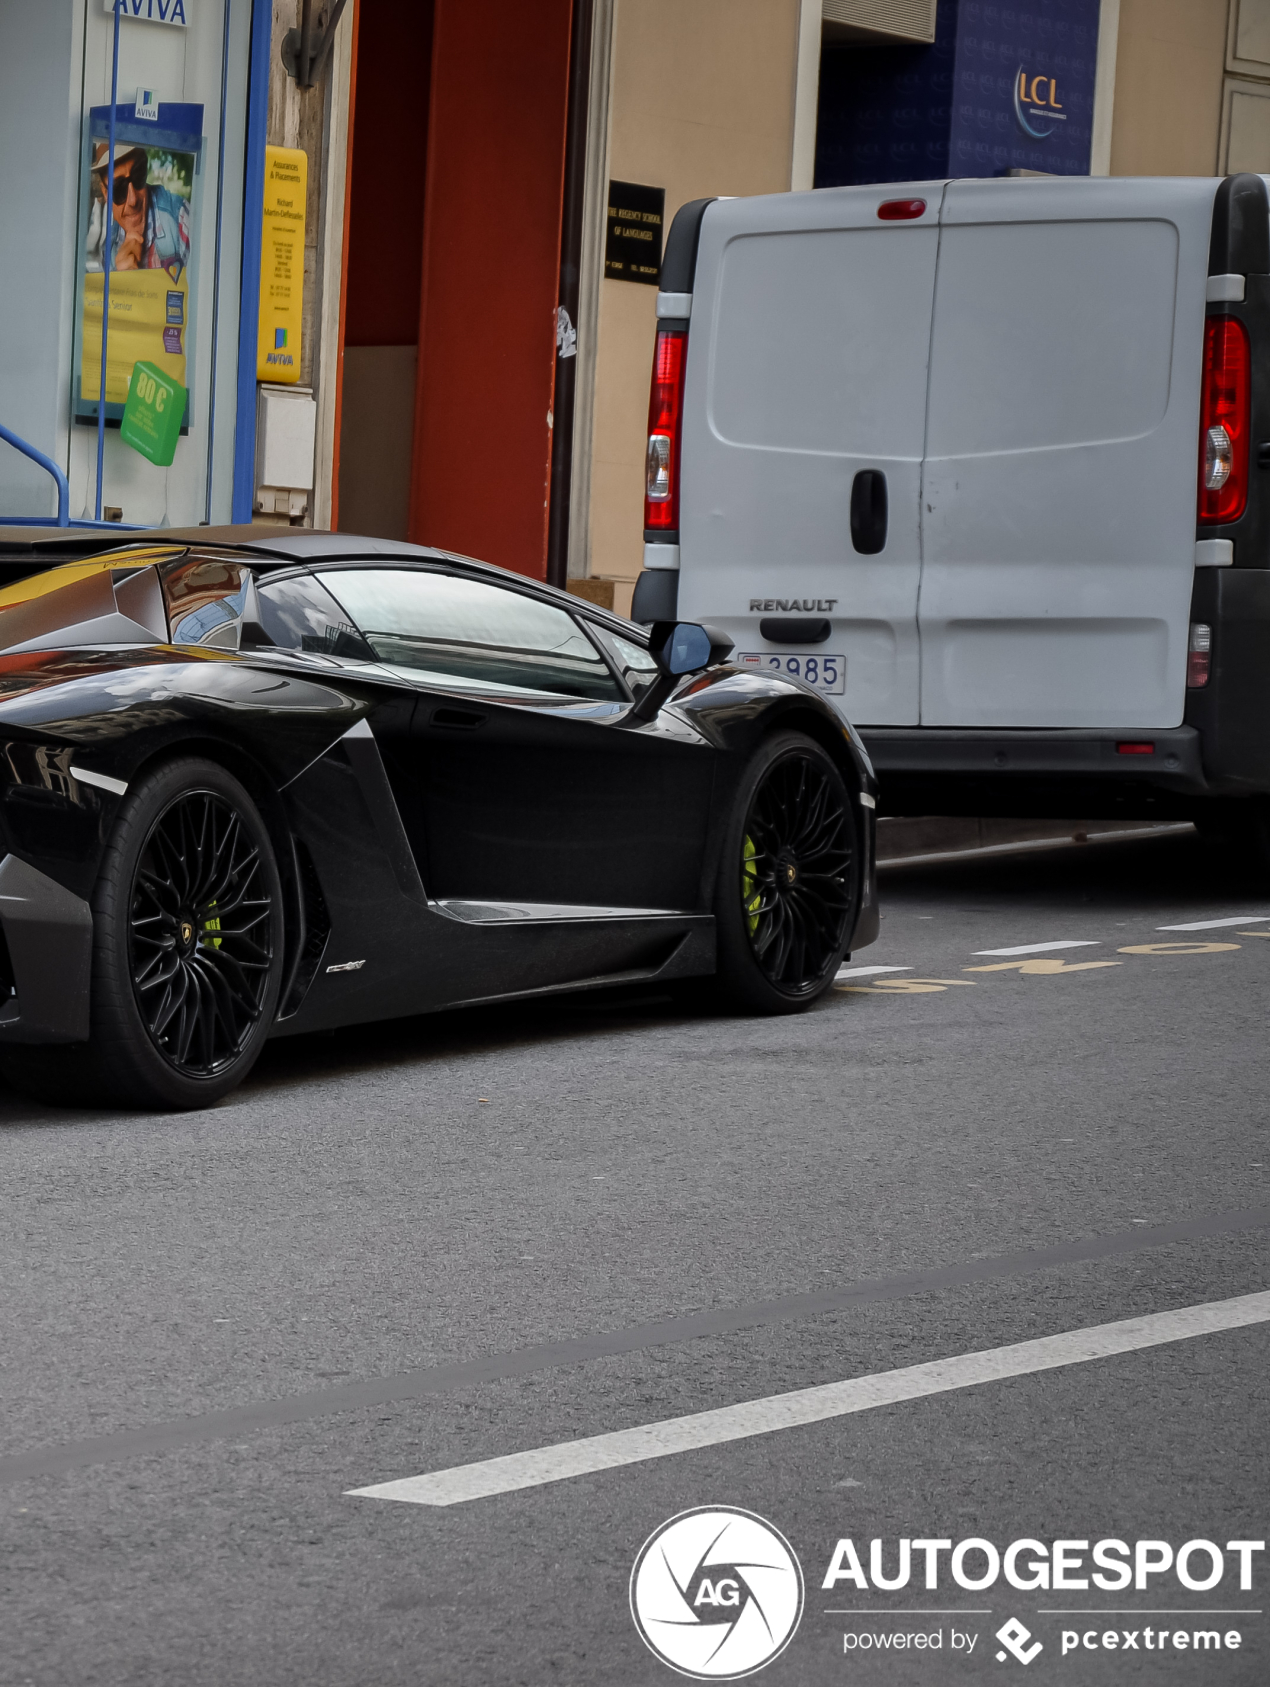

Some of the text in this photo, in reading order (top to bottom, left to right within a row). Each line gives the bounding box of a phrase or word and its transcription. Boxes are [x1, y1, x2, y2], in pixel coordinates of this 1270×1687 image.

[1020, 73, 1063, 108] LCL
[136, 108, 156, 118] AVIVA
[618, 208, 641, 221] REGENCY
[642, 212, 662, 224] SCHOOL
[614, 226, 652, 240] OF LANGUAGES
[266, 352, 294, 366] AVIVA
[136, 372, 156, 404] 80
[156, 387, 167, 413] €
[750, 599, 838, 612] RENAULT
